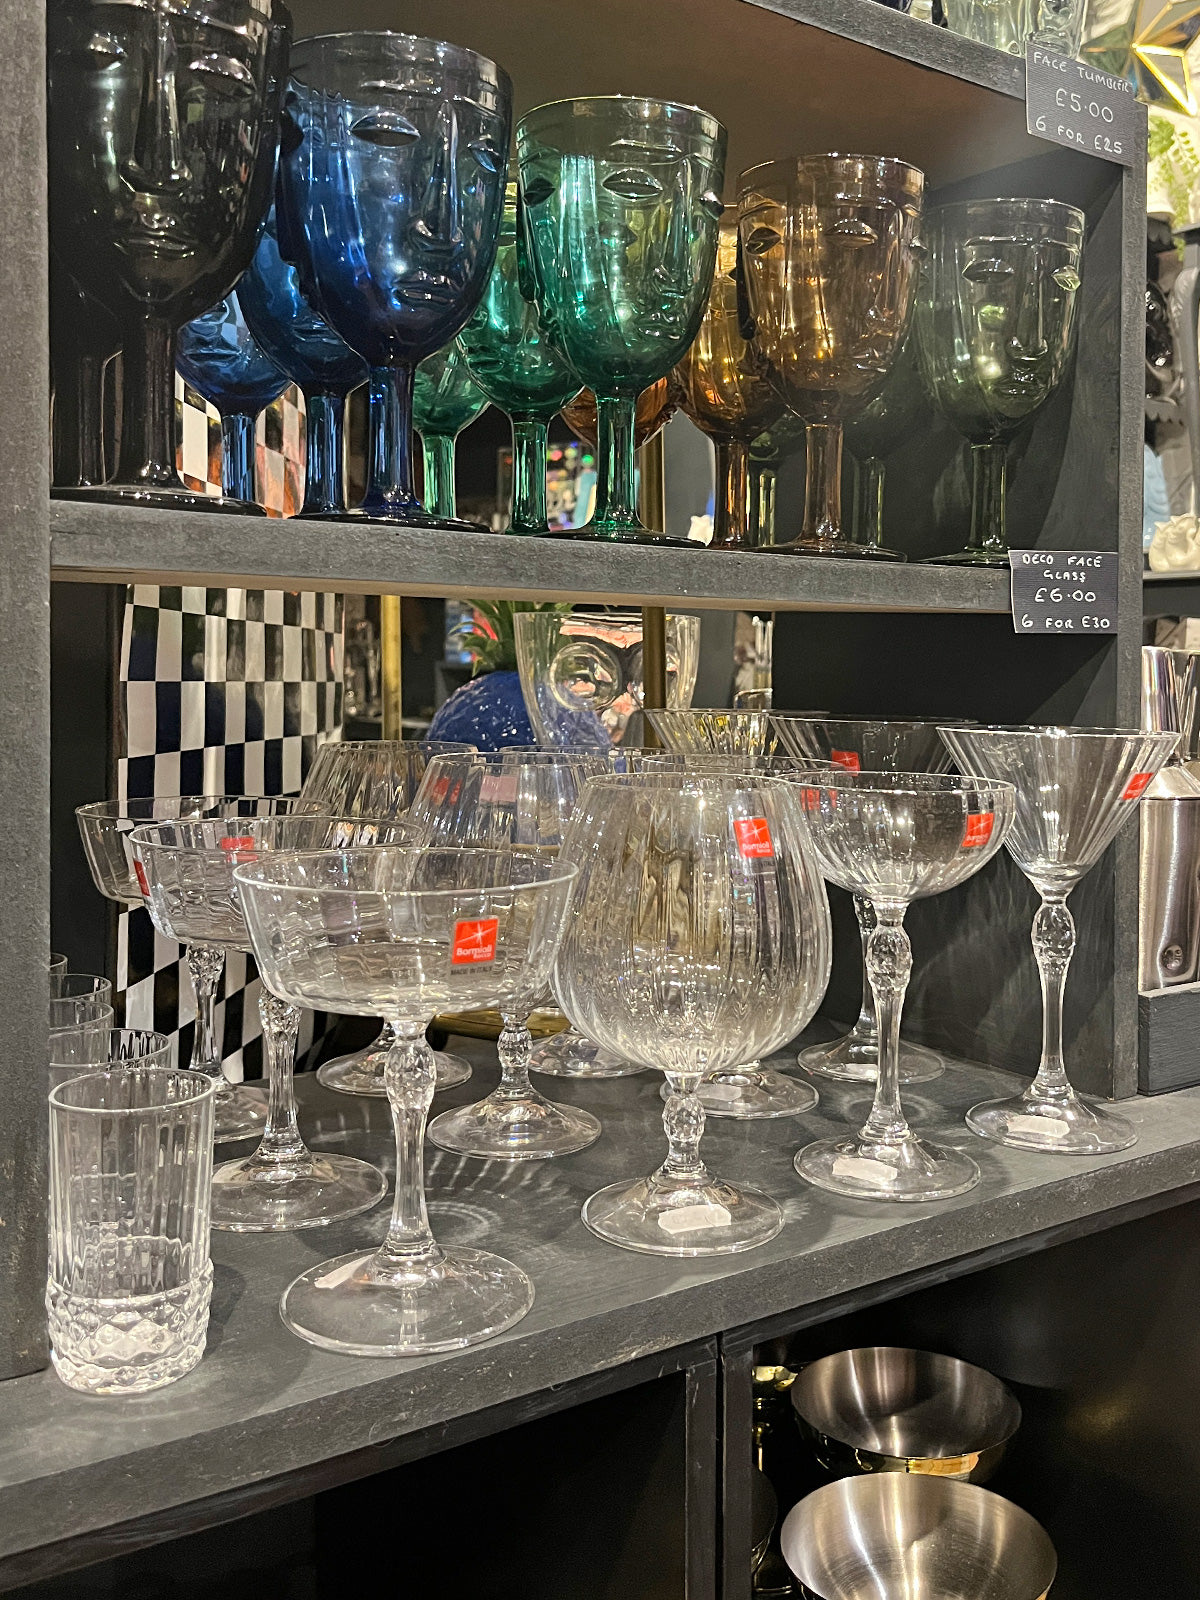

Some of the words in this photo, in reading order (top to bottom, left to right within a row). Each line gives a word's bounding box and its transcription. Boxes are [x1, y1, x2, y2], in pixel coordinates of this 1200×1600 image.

[1033, 51, 1067, 72] FACE
[1077, 66, 1130, 93] TUMBLER
[1035, 115, 1046, 131] 6
[1057, 125, 1085, 144] FOR
[1022, 553, 1054, 565] DECO
[1067, 555, 1103, 568] FACE
[1043, 569, 1086, 583] GLASS
[1021, 613, 1034, 628] 6
[1045, 617, 1074, 629] FOR
[456, 944, 493, 956] Bormioli
